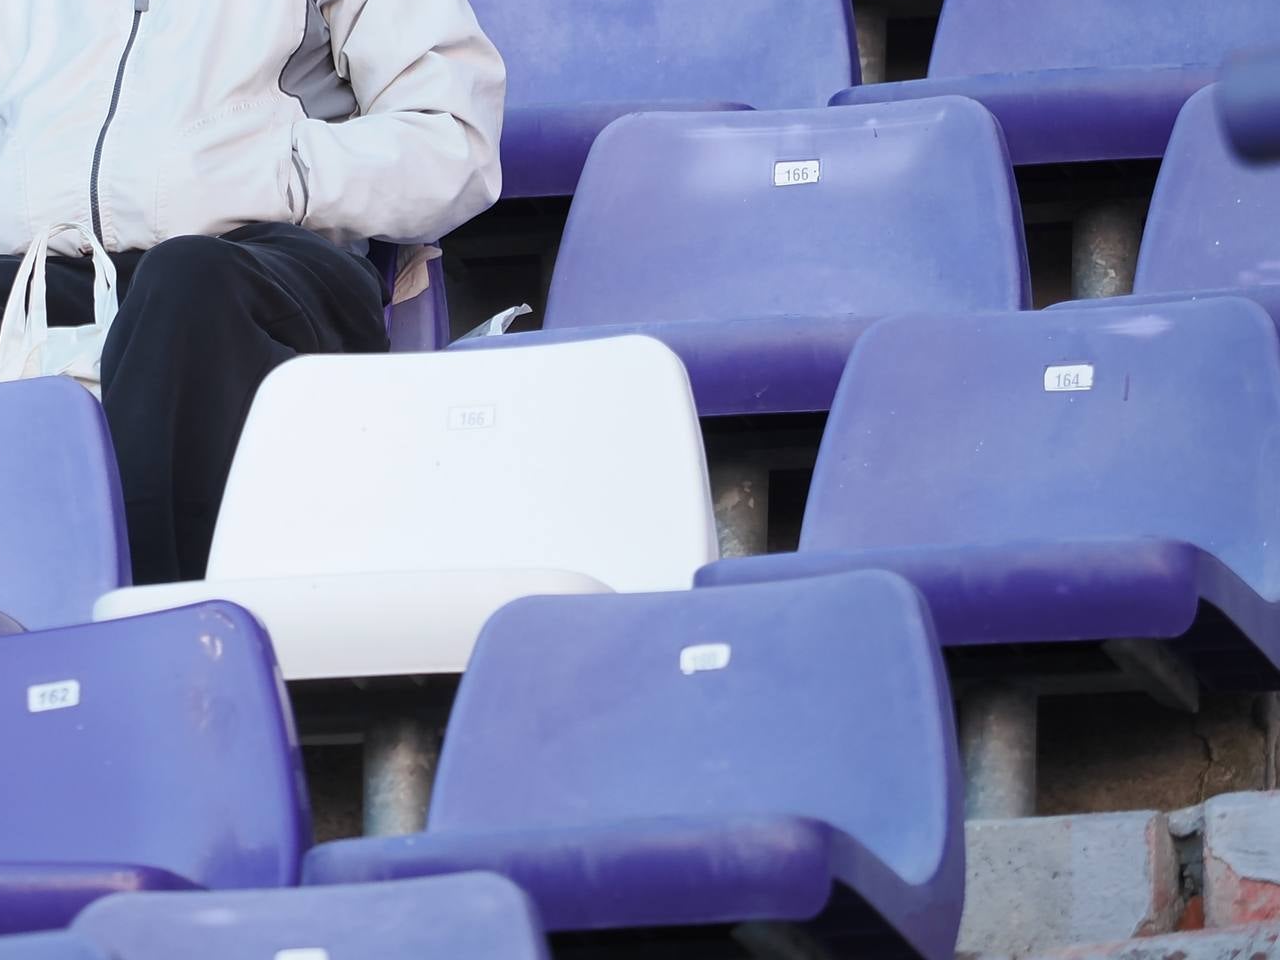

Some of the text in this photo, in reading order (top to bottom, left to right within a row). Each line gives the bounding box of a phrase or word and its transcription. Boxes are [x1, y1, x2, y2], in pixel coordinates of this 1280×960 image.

[786, 167, 809, 181] 166
[1056, 373, 1080, 387] 164
[460, 411, 485, 426] 166
[40, 687, 69, 705] 162
